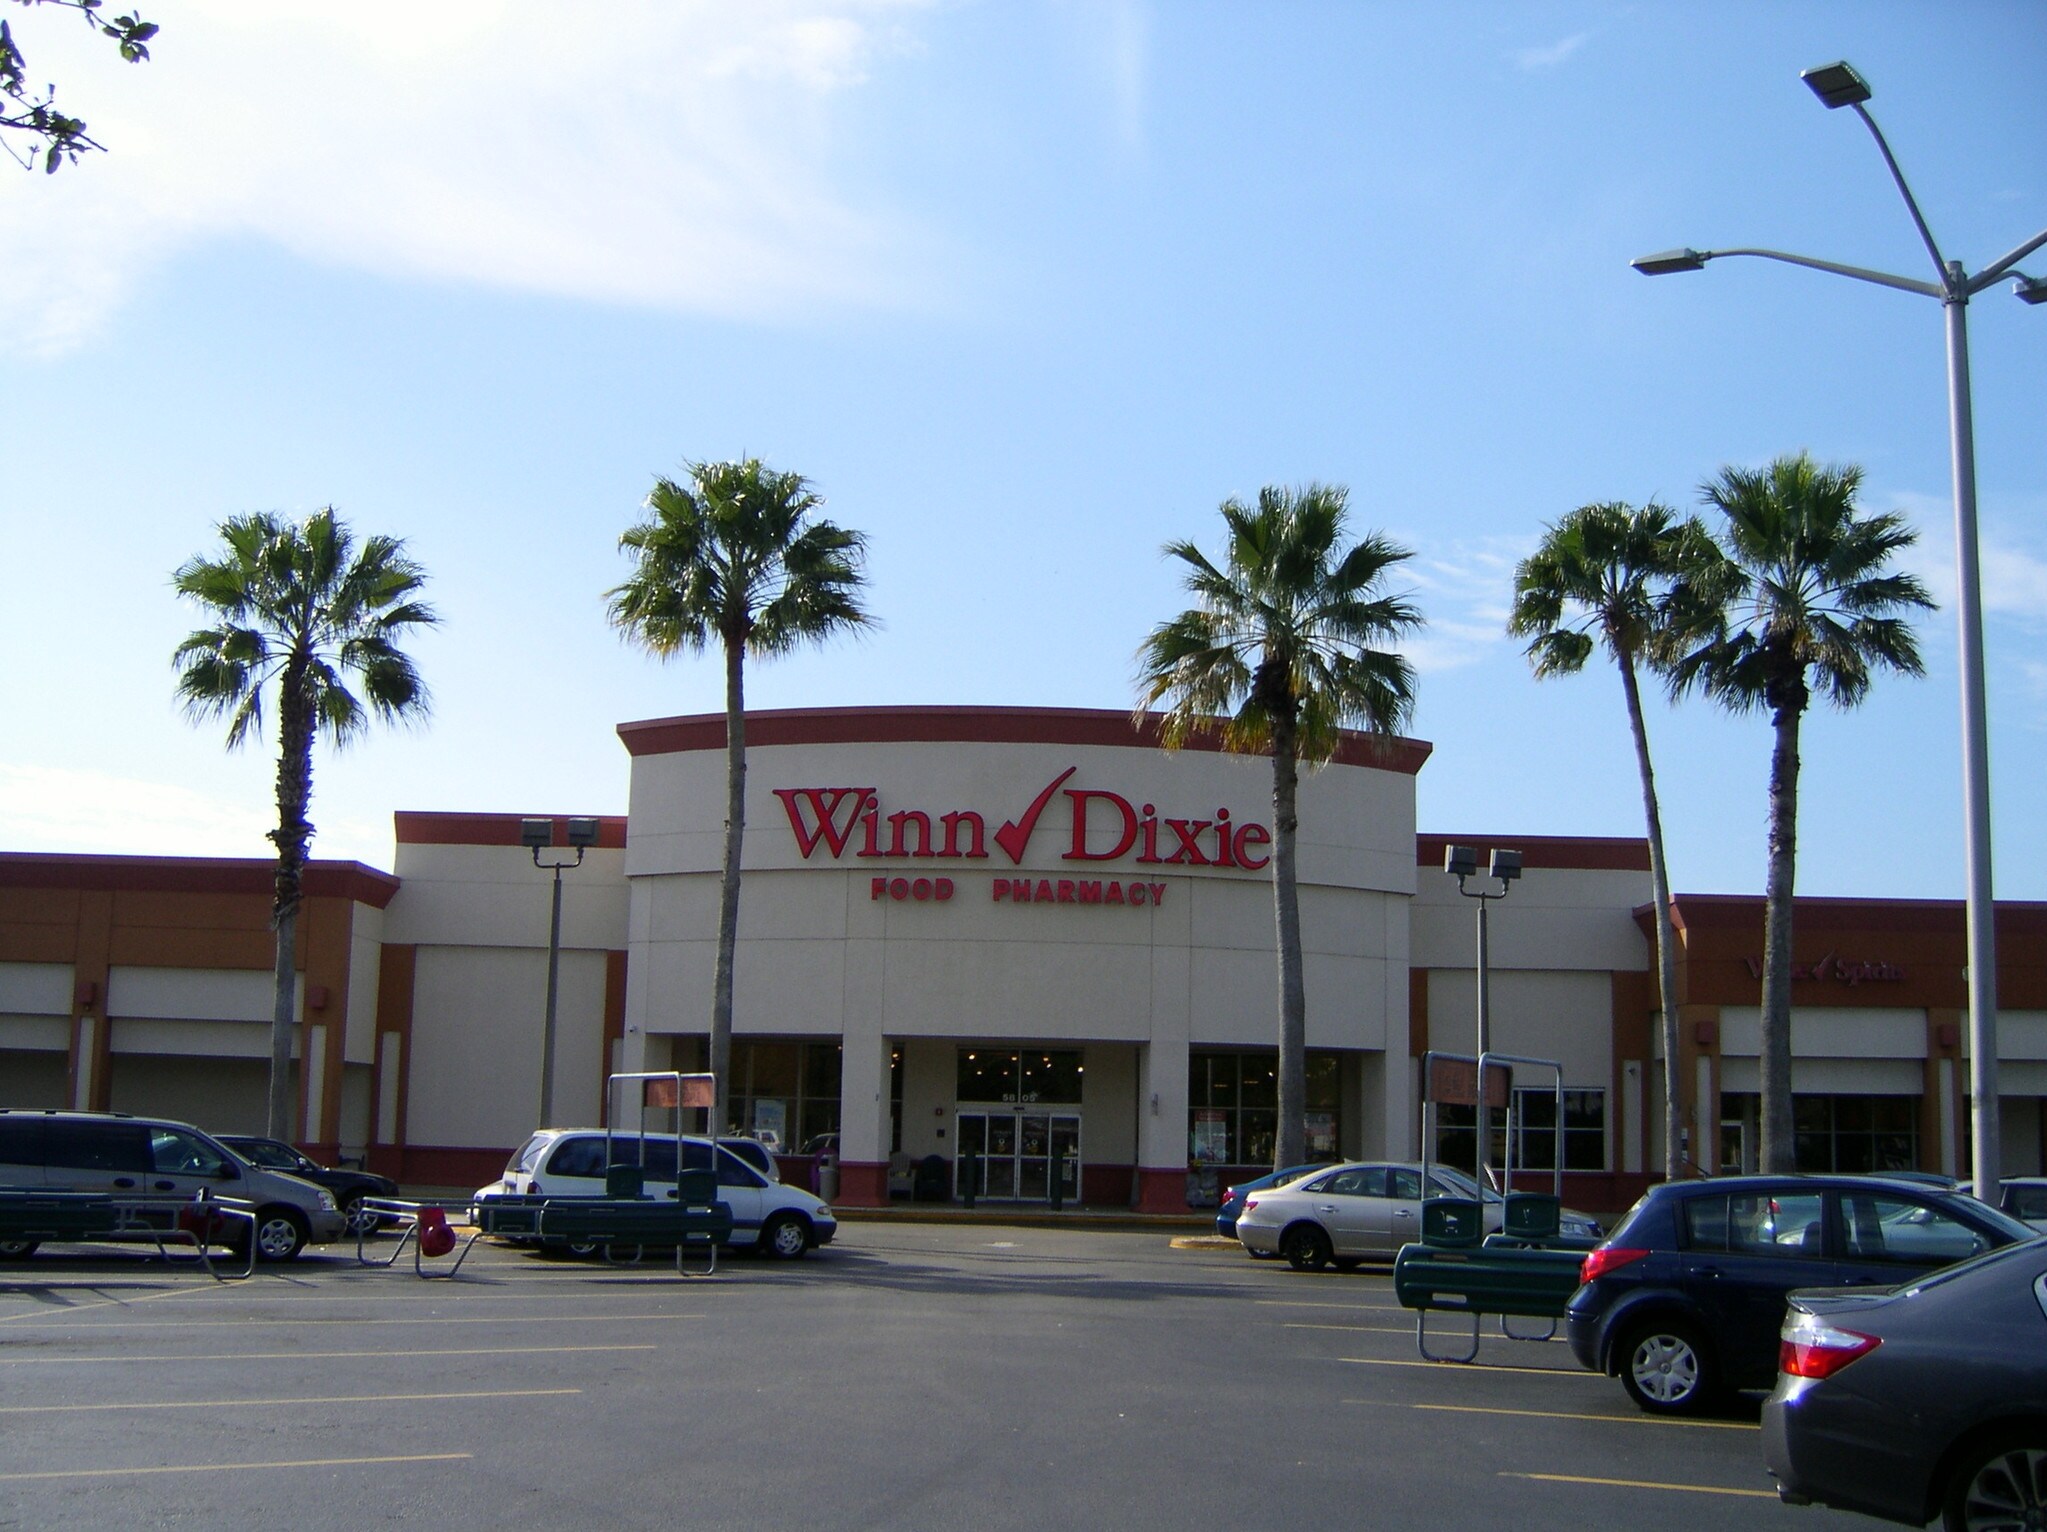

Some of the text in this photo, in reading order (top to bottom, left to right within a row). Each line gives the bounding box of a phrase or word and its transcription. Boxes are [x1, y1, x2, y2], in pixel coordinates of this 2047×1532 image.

[772, 787, 1271, 870] Winn Dixie
[871, 877, 1168, 906] FOOD PHARMACY
